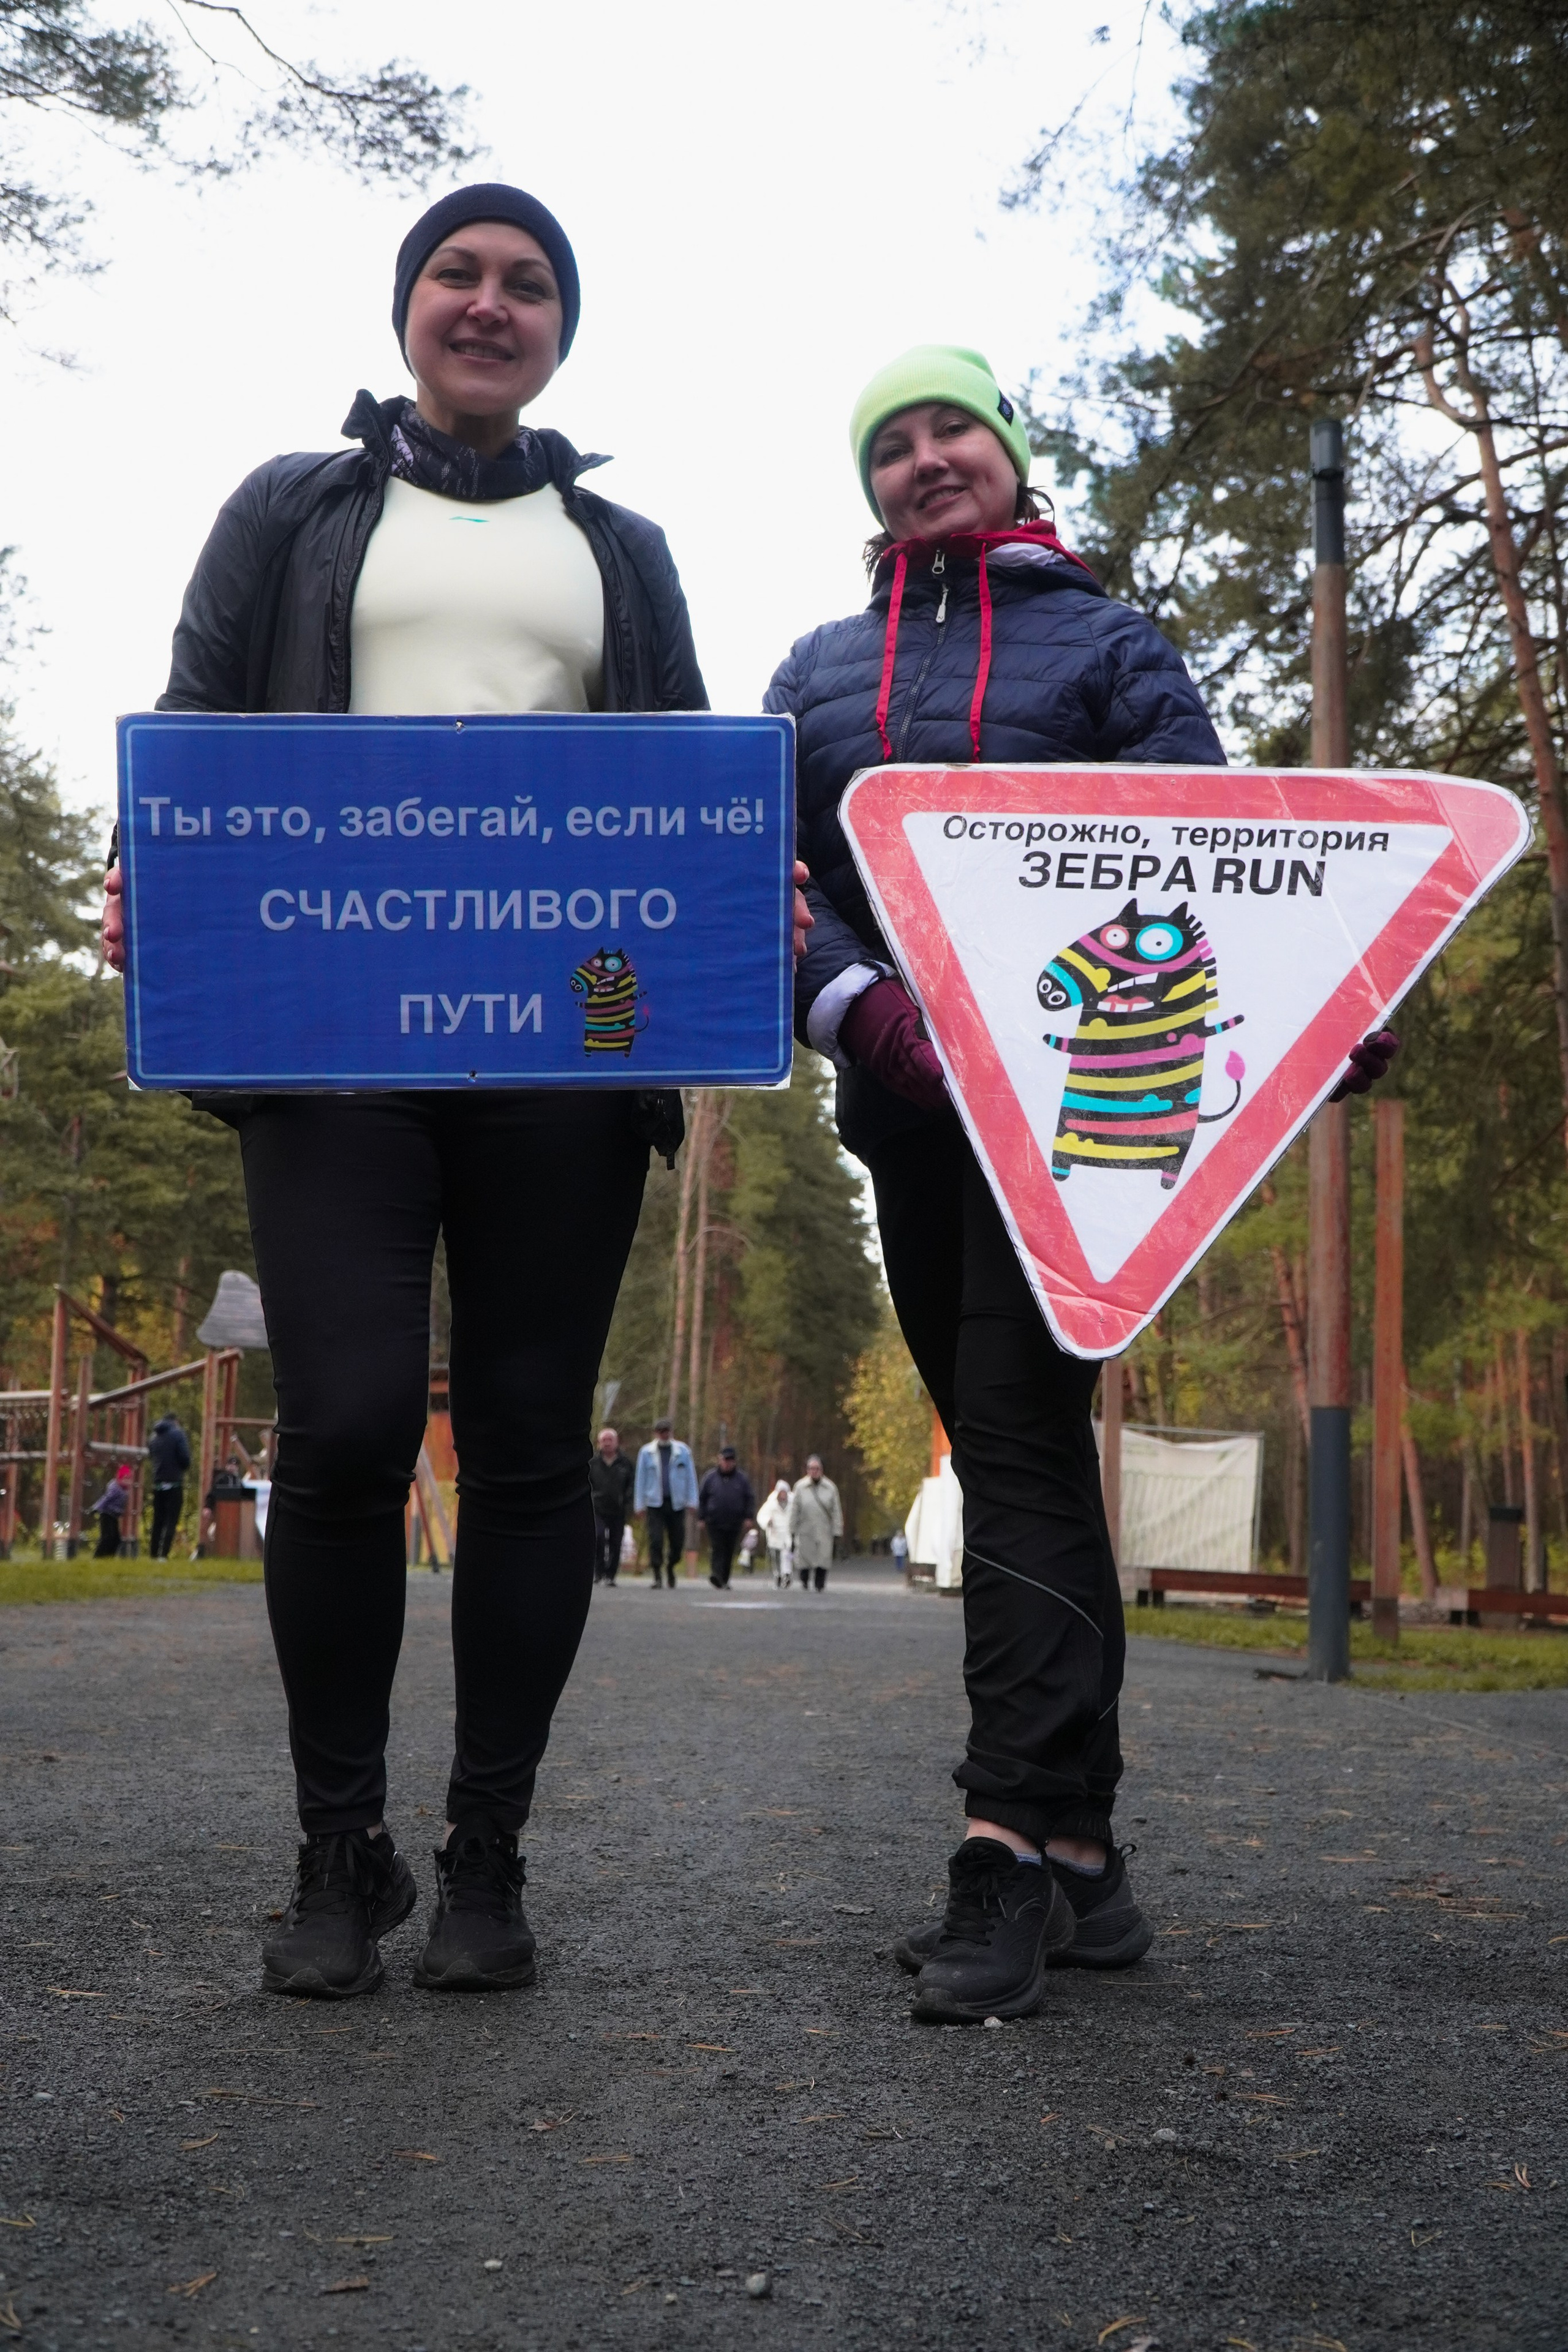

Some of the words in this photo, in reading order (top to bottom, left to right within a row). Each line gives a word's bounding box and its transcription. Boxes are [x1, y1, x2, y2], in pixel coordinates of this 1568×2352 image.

[138, 797, 211, 836] Ты
[227, 806, 325, 843] это,
[340, 796, 552, 843] забегай,
[567, 806, 685, 836] если
[700, 797, 764, 834] чё!
[943, 815, 1150, 850] Осторожно,
[1171, 827, 1389, 856] территория
[1018, 850, 1197, 892] ЗЕБРА
[1212, 857, 1326, 897] RUN
[260, 888, 677, 931] СЧАСТЛИВОГО
[400, 993, 543, 1034] ПУТИ
